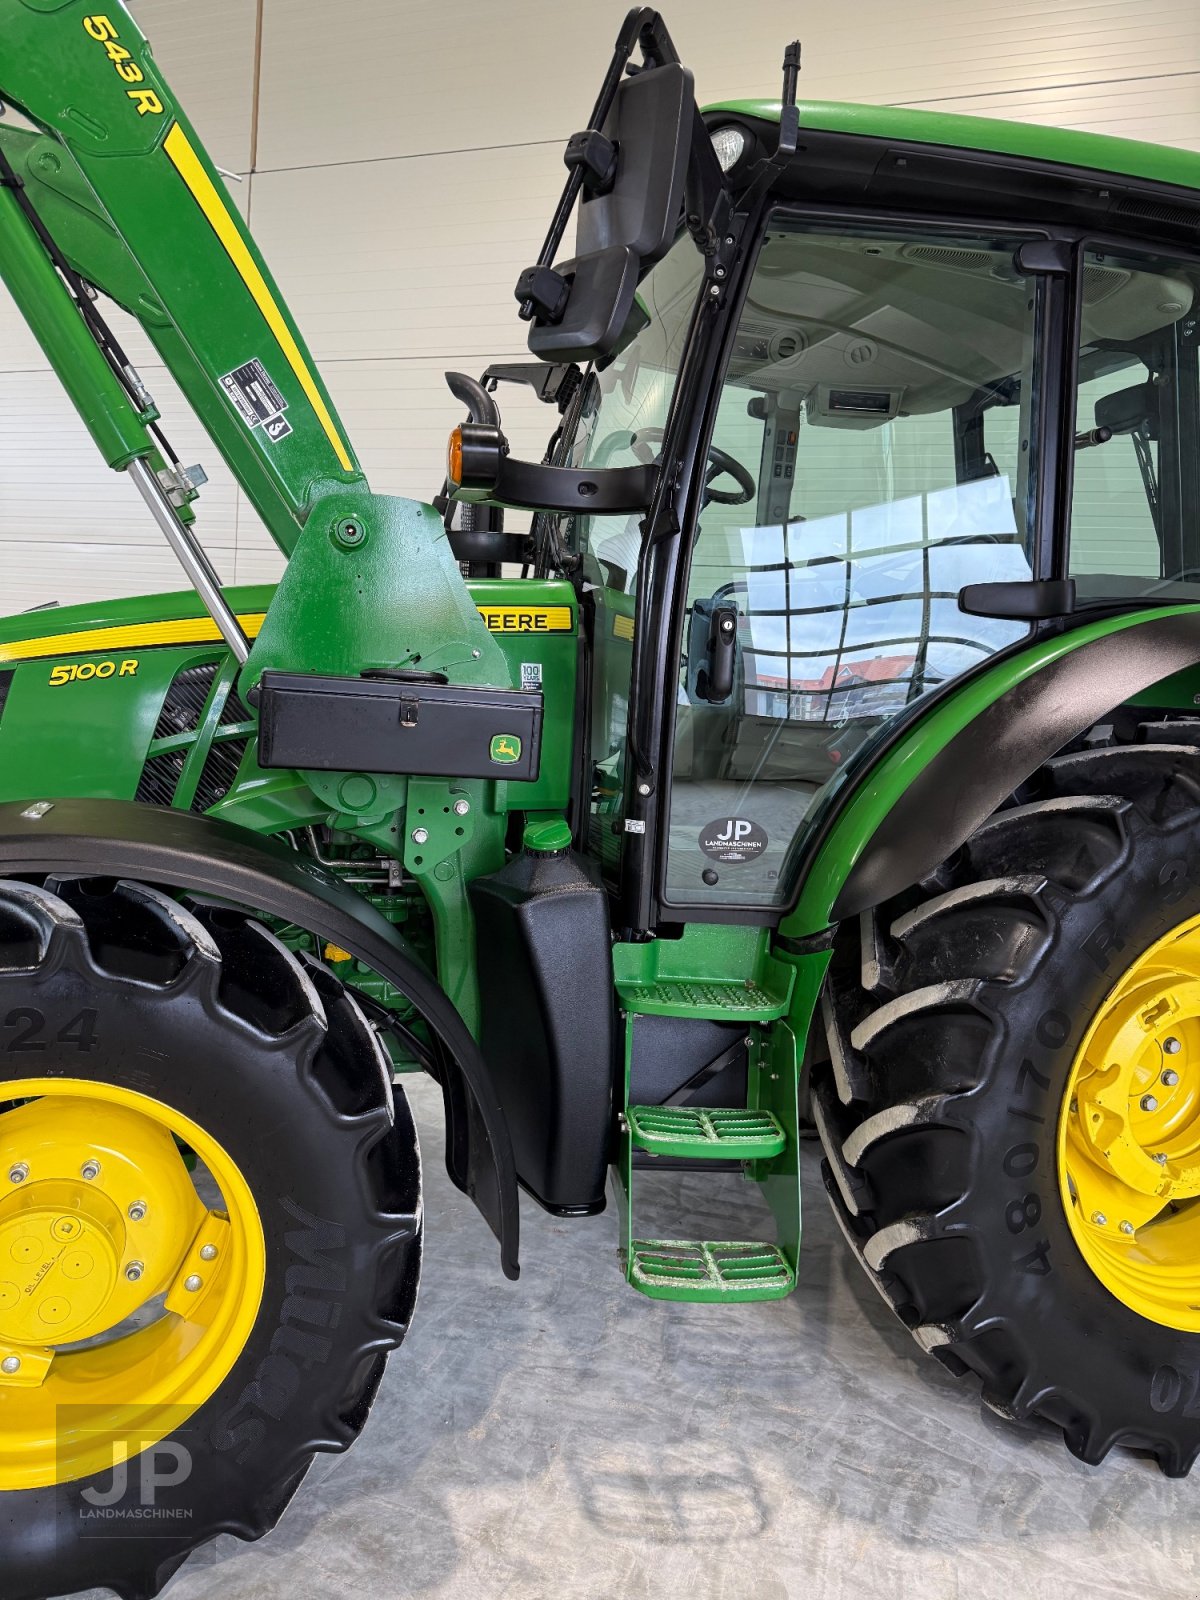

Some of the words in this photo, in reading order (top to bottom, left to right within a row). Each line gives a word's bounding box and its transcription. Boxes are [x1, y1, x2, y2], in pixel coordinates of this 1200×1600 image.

[83, 15, 145, 83] 543
[126, 88, 165, 118] R
[49, 661, 116, 686] 5100
[119, 659, 139, 677] R
[523, 666, 539, 676] 100
[705, 840, 762, 848] LANDMASCHINEN
[716, 820, 752, 841] JP
[3, 1006, 99, 1052] 24
[1003, 1009, 1071, 1276] 480/70
